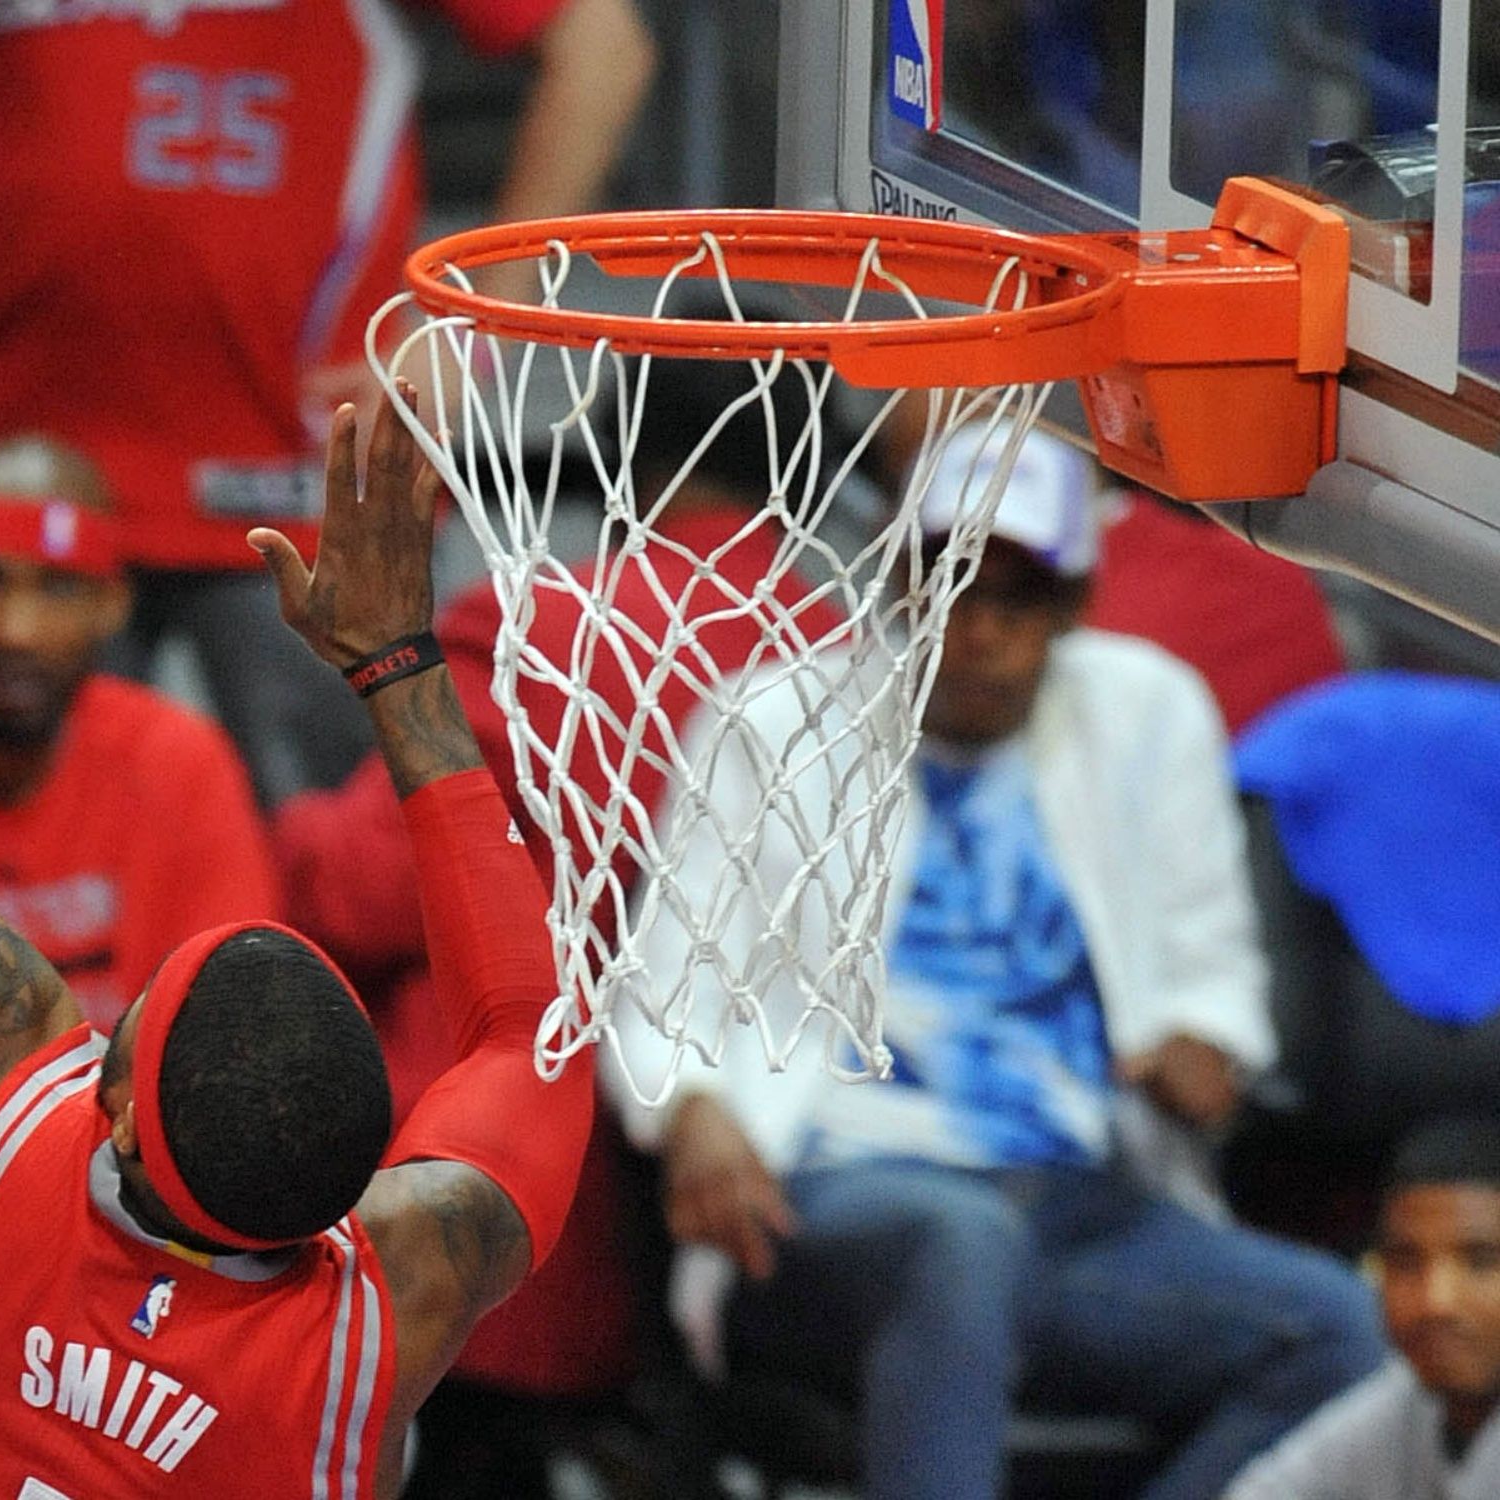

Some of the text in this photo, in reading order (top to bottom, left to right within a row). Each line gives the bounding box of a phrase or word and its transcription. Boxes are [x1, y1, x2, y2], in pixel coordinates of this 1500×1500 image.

[128, 64, 288, 190] 25
[893, 53, 925, 110] NBA
[19, 1325, 220, 1474] SMITH
